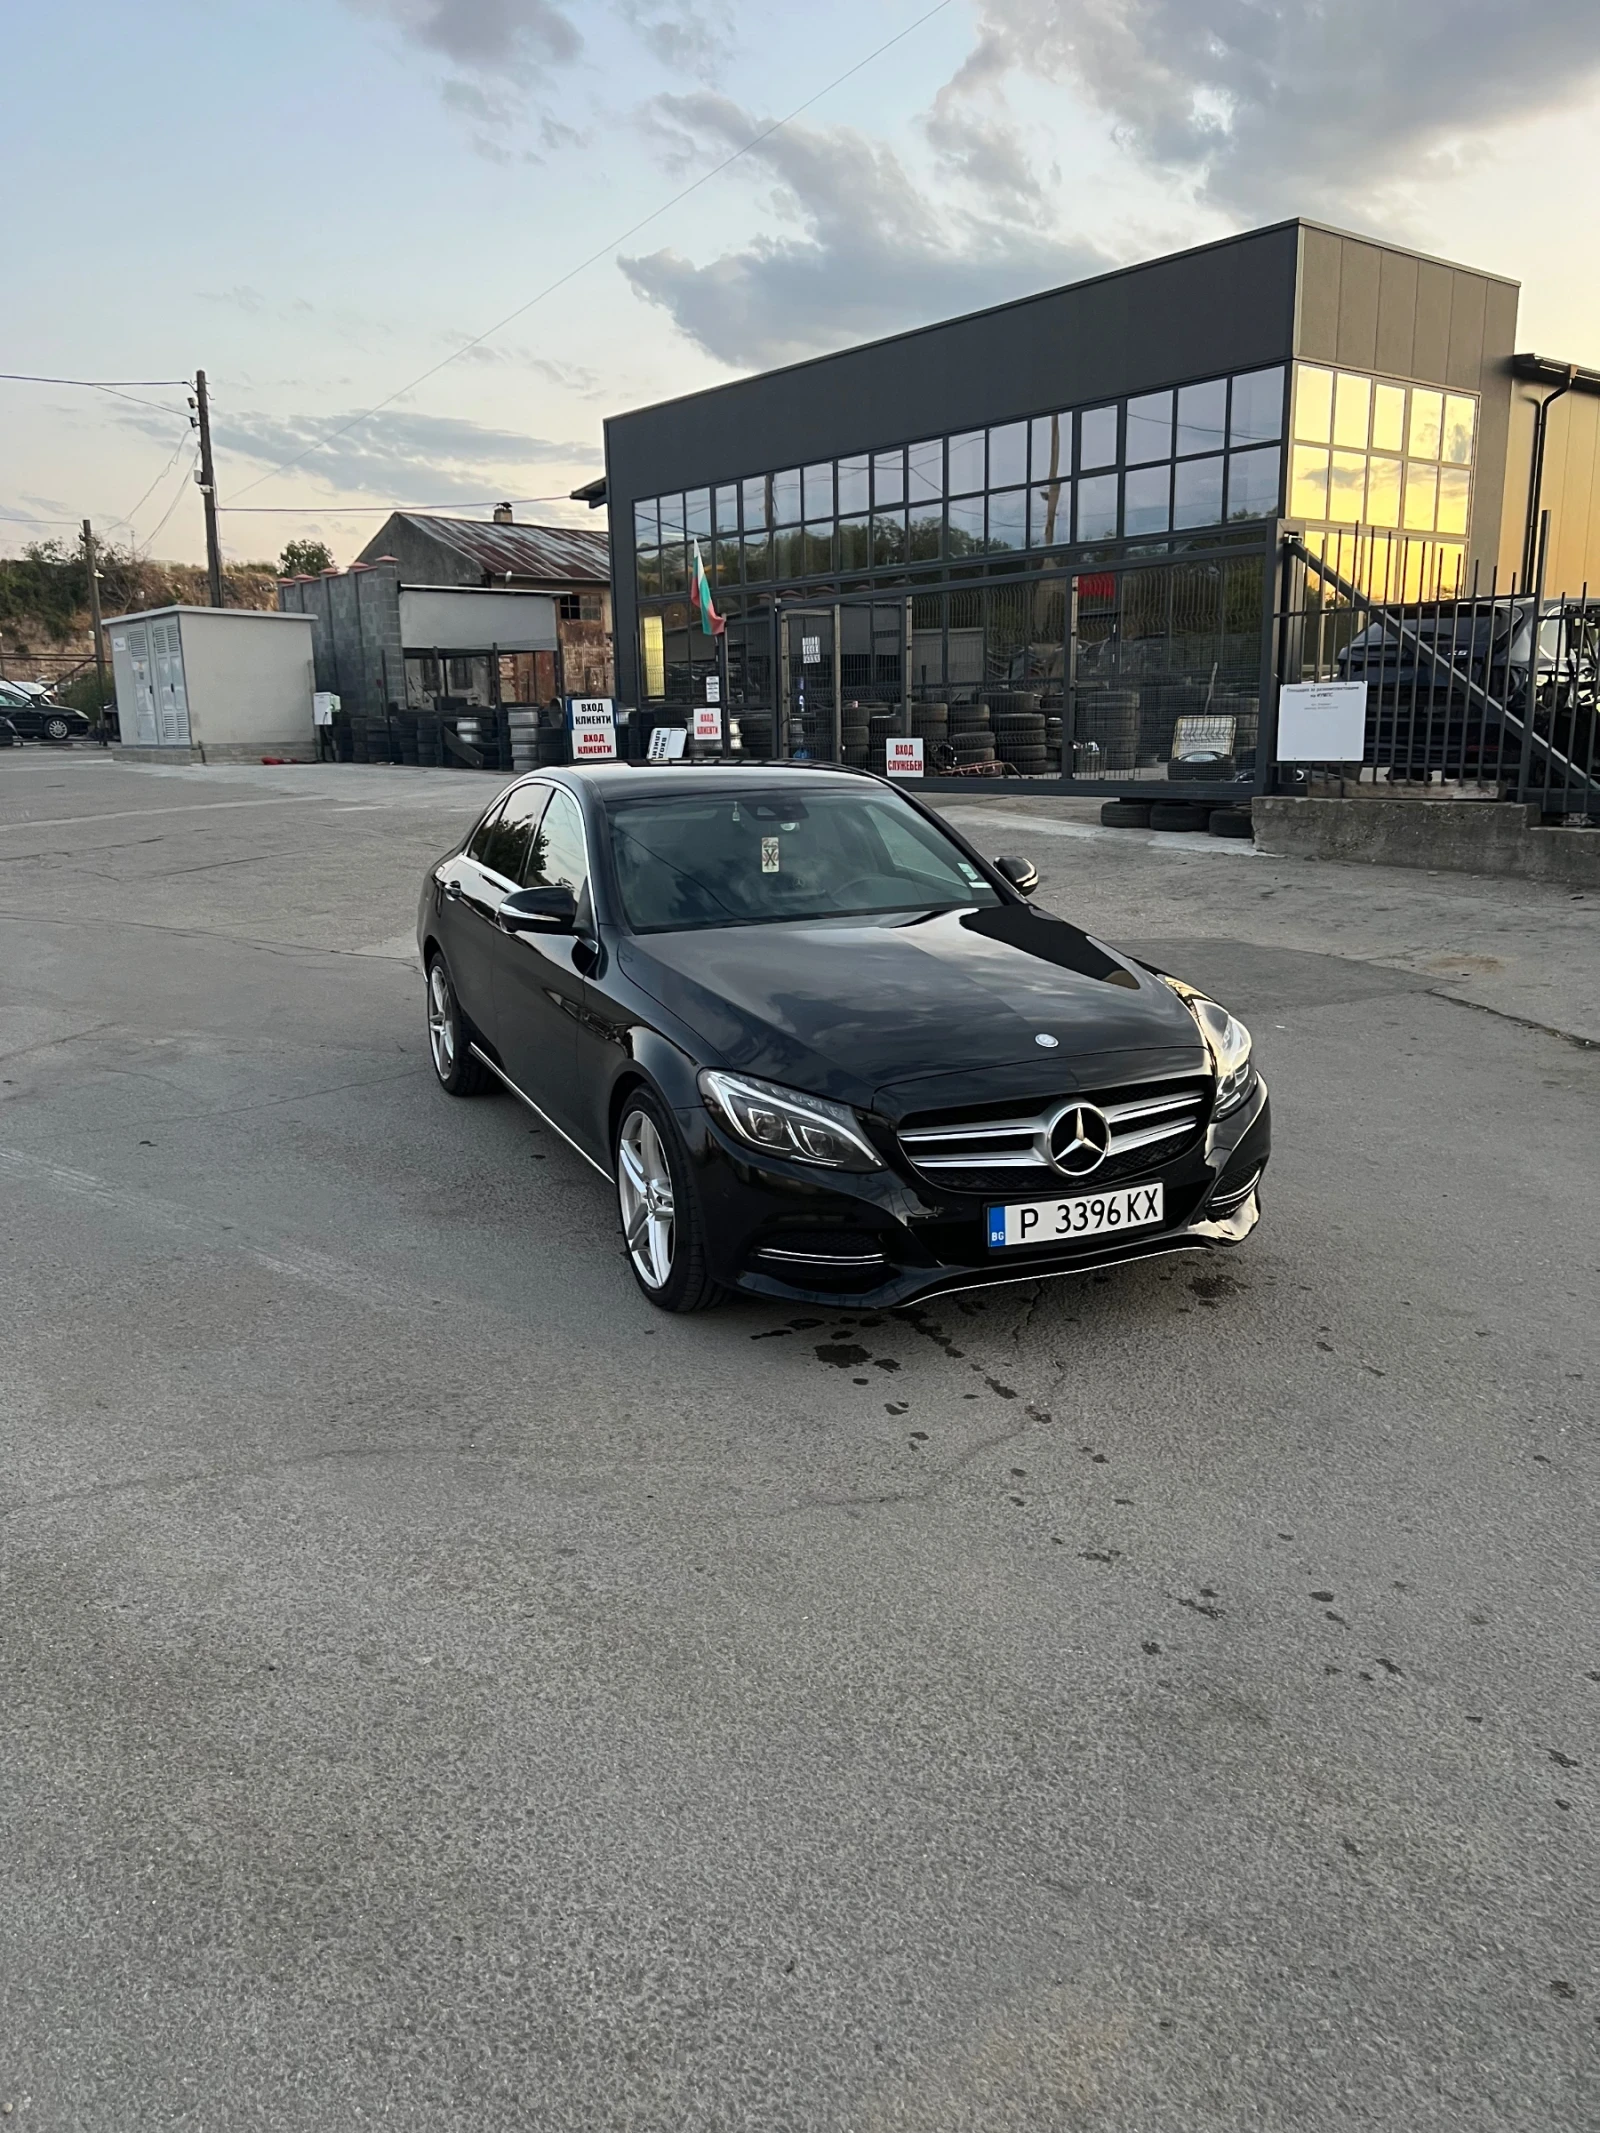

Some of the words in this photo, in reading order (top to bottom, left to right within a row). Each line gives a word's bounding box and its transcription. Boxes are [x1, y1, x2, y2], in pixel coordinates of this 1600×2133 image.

[581, 703, 604, 713] ВХОД
[575, 715, 612, 725] КЛИЕНТИ
[583, 734, 605, 743] ВХОД
[577, 745, 613, 755] КЛИЕНТИ
[895, 744, 914, 757] ВХОД
[888, 760, 922, 771] СЛУЖЕБЕН
[1020, 1208, 1039, 1239] P
[991, 1231, 1005, 1242] BG
